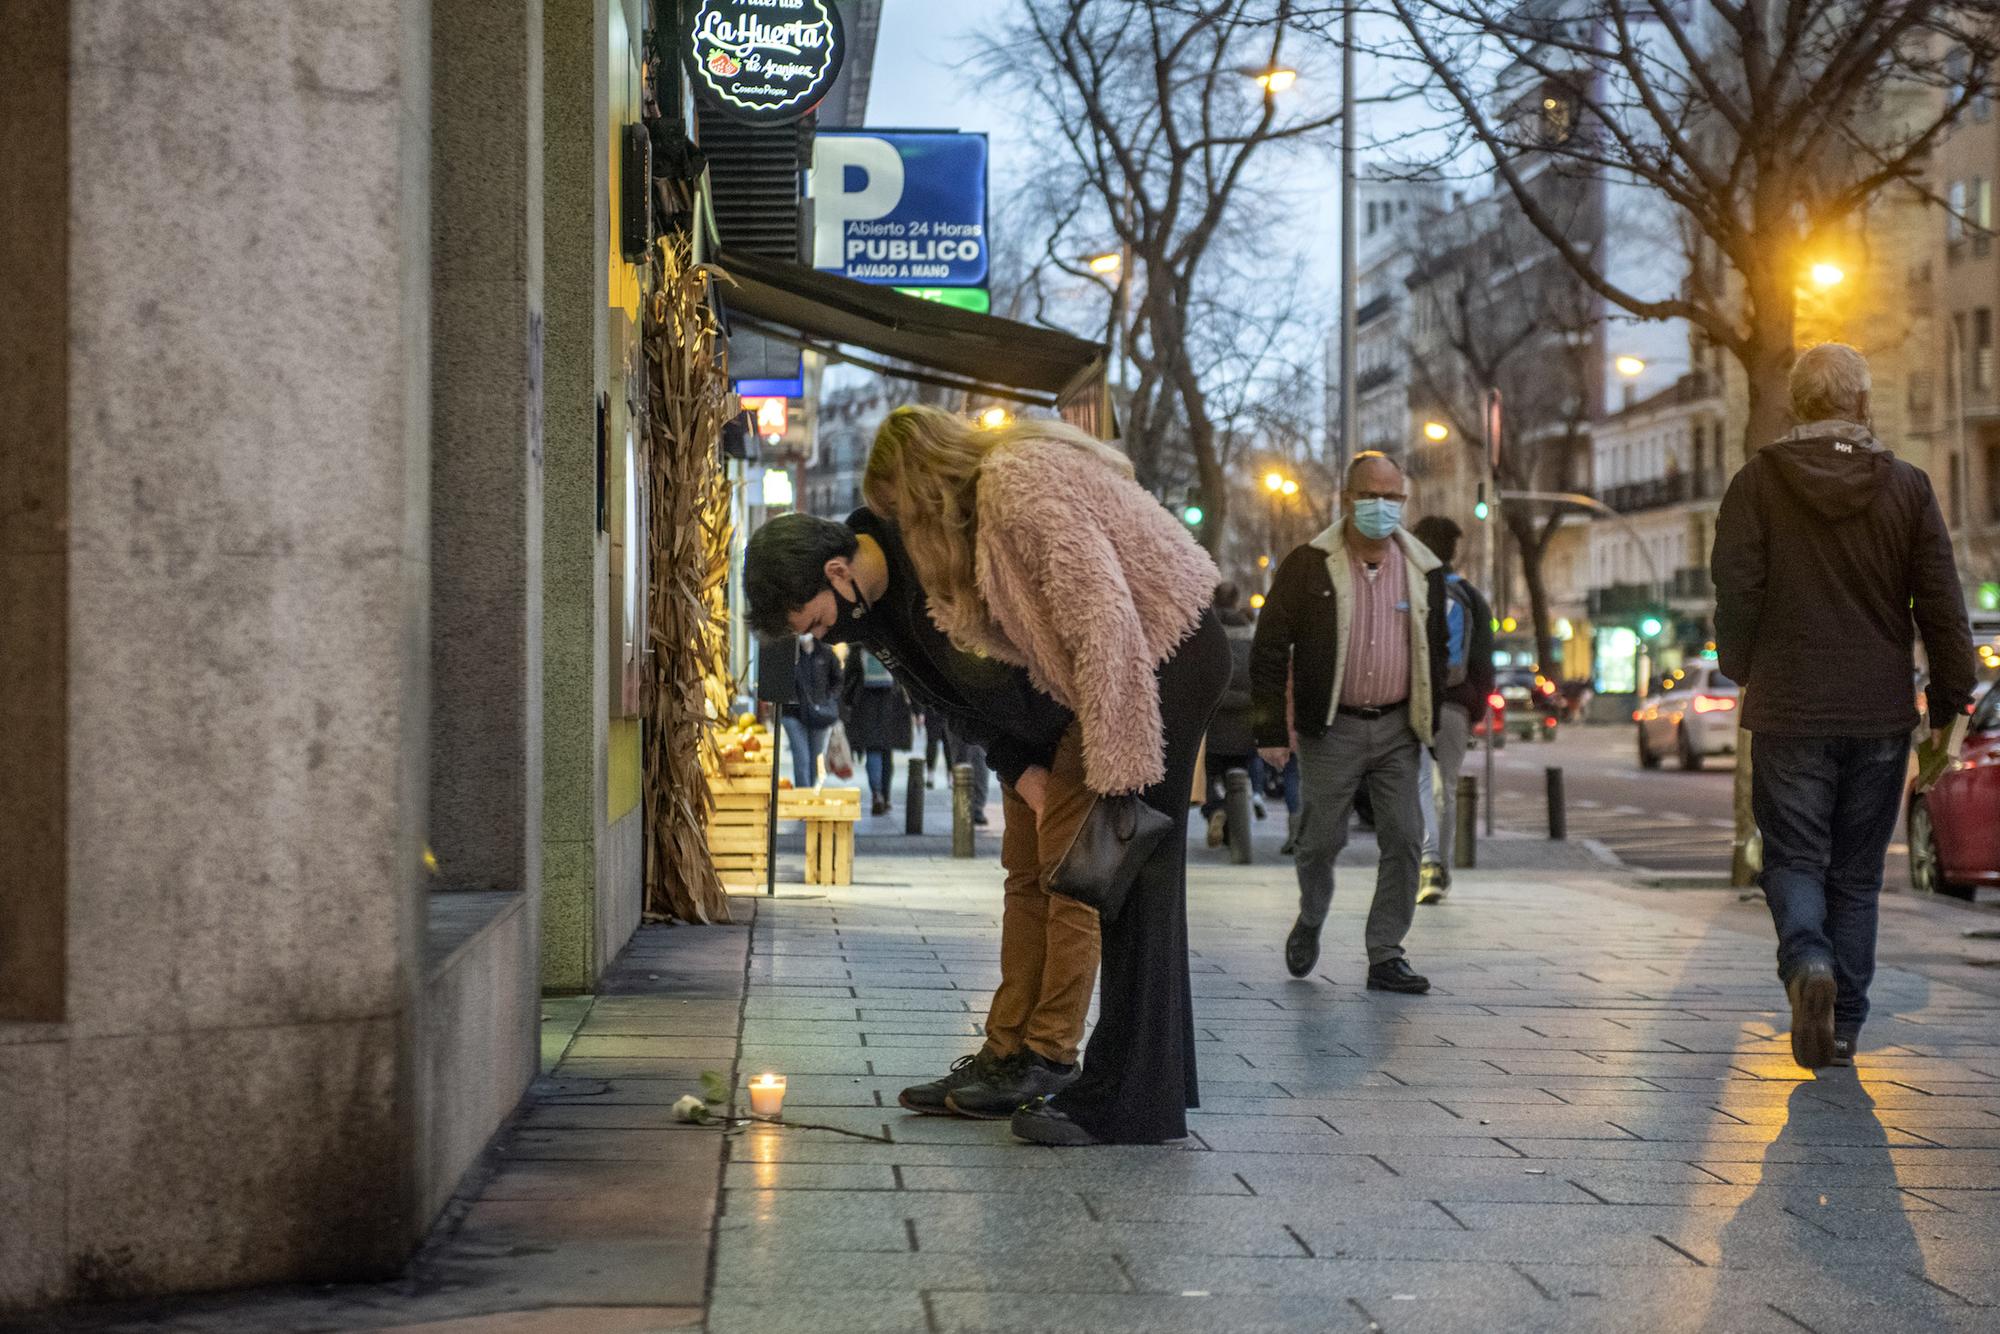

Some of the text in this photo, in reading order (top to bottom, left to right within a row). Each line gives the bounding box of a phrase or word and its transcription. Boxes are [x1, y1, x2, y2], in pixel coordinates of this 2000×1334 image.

[697, 10, 825, 56] La Huerta
[812, 136, 904, 268] P
[847, 221, 982, 236] Abierto 24 Horas
[847, 239, 980, 261] PUBLICO
[847, 264, 950, 278] LAVADO A MANO
[1835, 441, 1853, 453] HH
